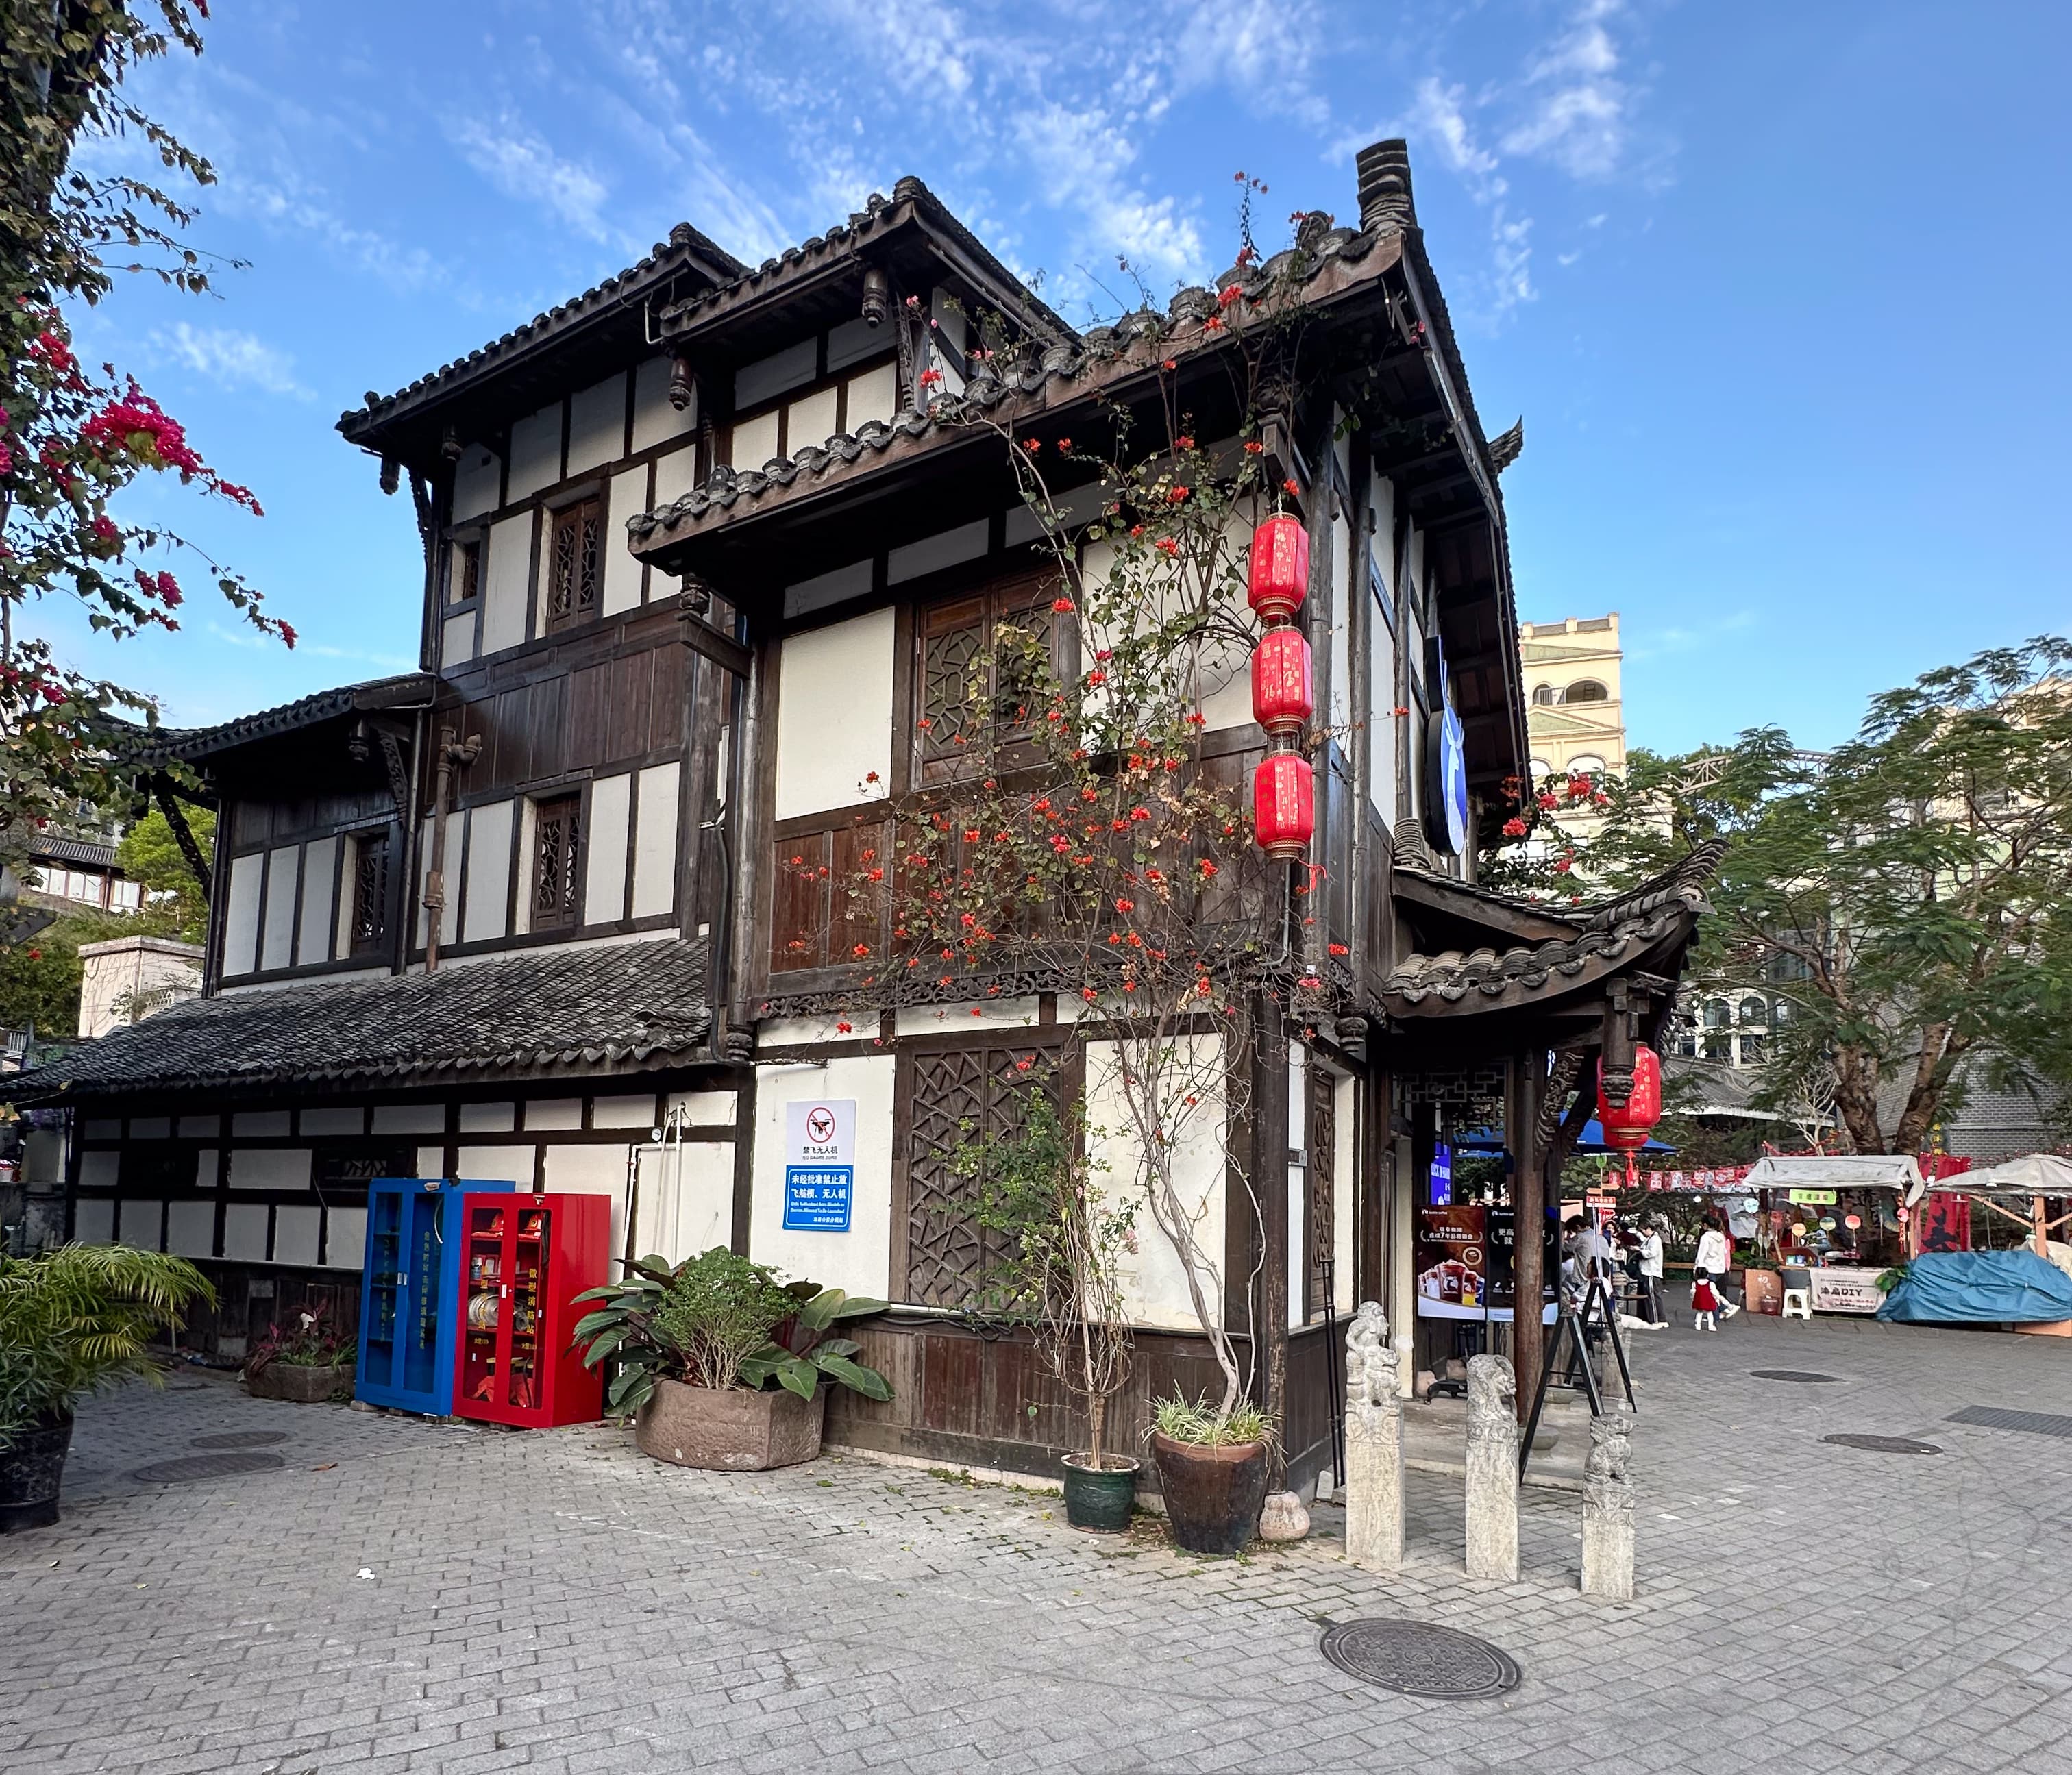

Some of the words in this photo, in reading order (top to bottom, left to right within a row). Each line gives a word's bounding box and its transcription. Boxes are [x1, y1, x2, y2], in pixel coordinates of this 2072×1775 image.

[803, 1145, 838, 1154] 禁飞无人机
[791, 1174, 847, 1184] 未经批准禁止放
[527, 1268, 537, 1335] 微型消防站
